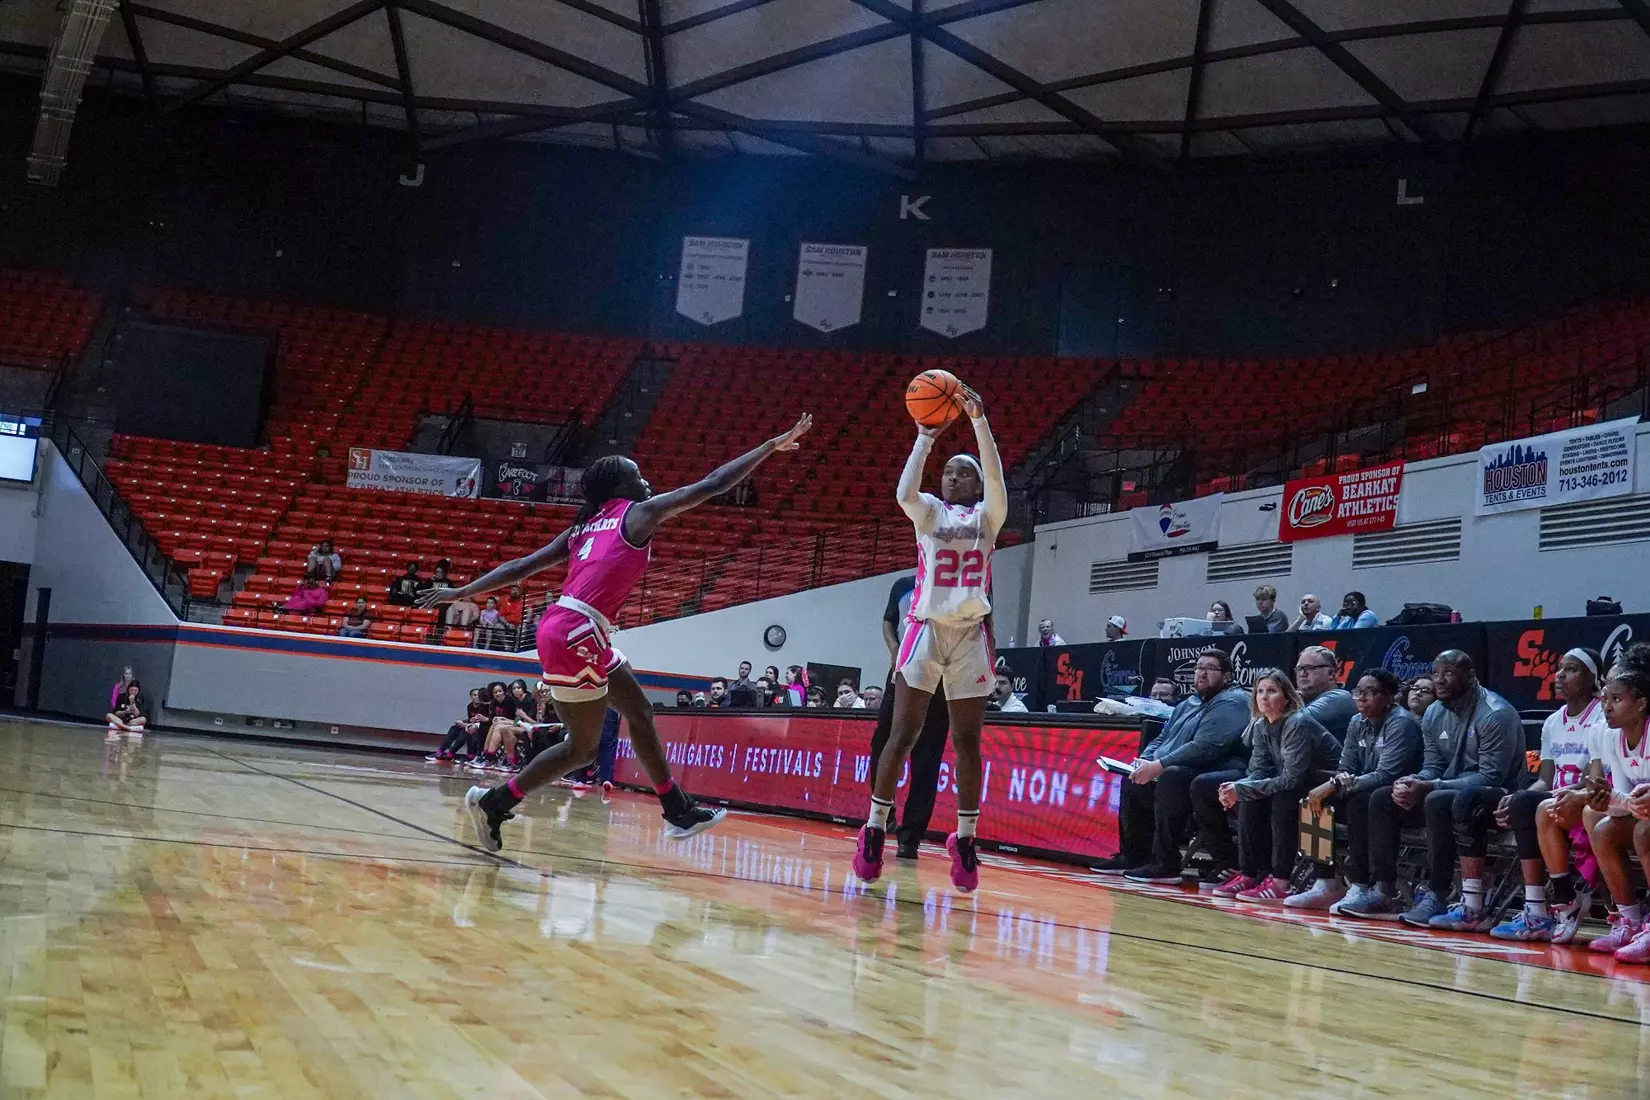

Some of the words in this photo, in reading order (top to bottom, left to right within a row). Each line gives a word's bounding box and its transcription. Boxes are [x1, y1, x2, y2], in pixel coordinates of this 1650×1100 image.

[399, 164, 424, 186] J
[1397, 180, 1424, 204] L
[900, 195, 931, 219] K
[1338, 473, 1360, 485] PROUD
[1360, 468, 1391, 481] SPONSOR
[1391, 466, 1401, 475] OF
[1484, 459, 1548, 495] HOUSTON
[1559, 458, 1628, 476] houstontents.com
[347, 472, 381, 481] PROUD
[383, 475, 428, 487] SPONSOR
[430, 479, 444, 487] OF
[1342, 477, 1397, 500] BEARKAT
[1559, 469, 1628, 492] 713-346-2012
[1289, 485, 1334, 528] Cane's
[1337, 494, 1400, 518] ATHLETICS
[1484, 492, 1508, 504] TENTS
[1508, 490, 1514, 500] &
[1516, 486, 1547, 498] EVENTS
[577, 536, 596, 560] 4
[934, 550, 984, 587] 22
[1168, 643, 1217, 663] JOHNSON
[665, 741, 724, 769] TAILGATES
[744, 747, 822, 779] FESTIVALS
